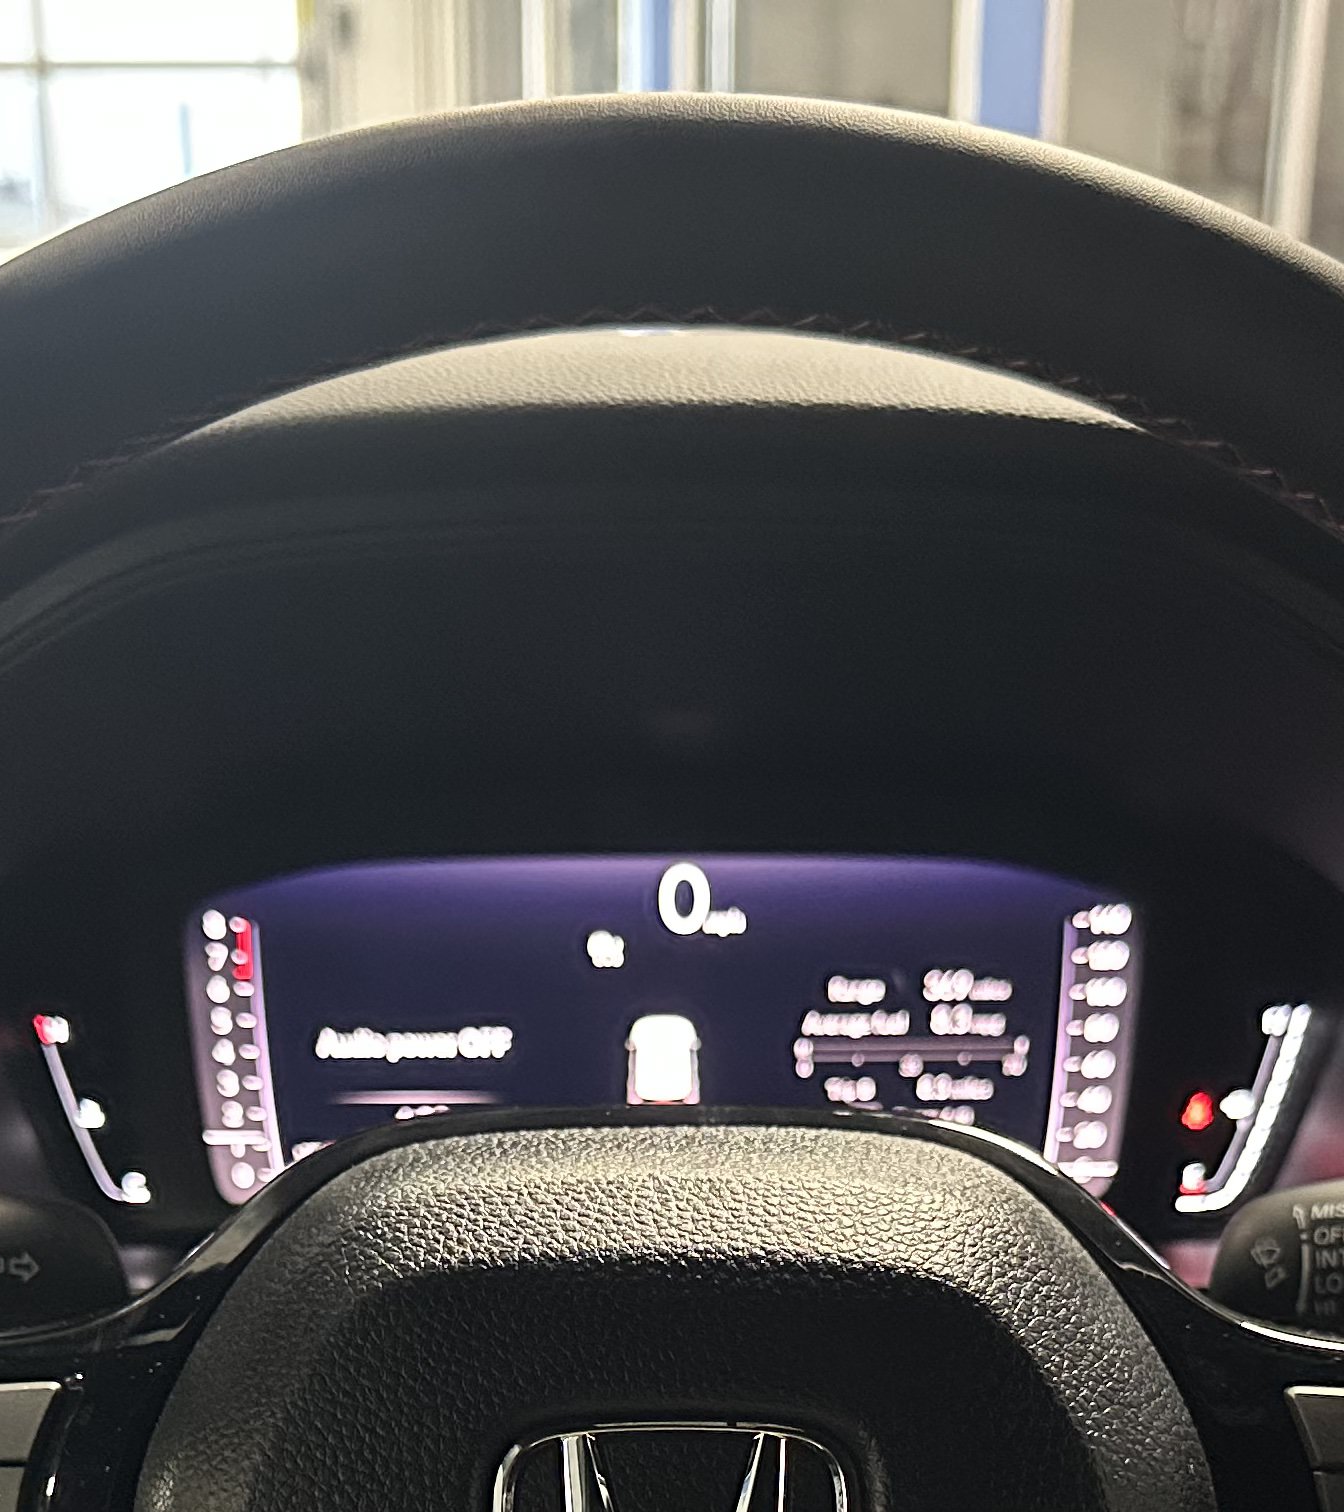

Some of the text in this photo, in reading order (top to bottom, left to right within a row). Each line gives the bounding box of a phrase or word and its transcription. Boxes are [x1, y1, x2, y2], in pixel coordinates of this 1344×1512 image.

[658, 862, 711, 935] 0
[315, 1027, 386, 1059] Audio
[457, 1026, 514, 1059] OFF
